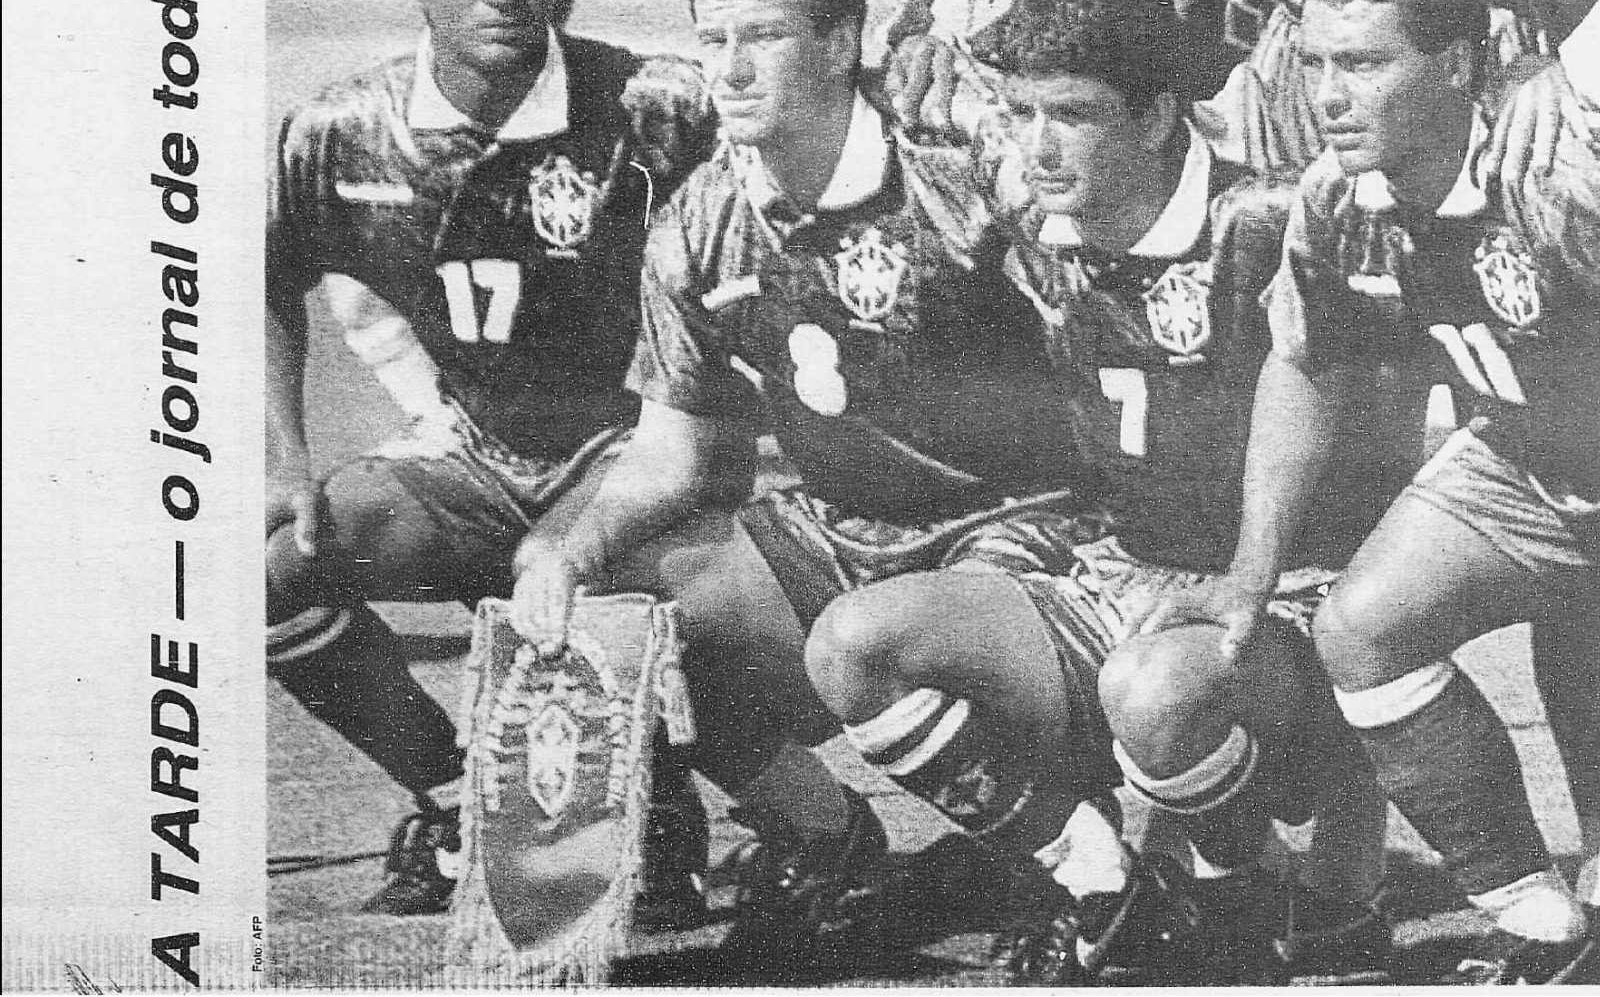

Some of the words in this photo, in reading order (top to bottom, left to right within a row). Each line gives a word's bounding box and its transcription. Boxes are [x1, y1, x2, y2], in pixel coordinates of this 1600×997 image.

[151, 133, 198, 224] de
[435, 258, 521, 344] 17
[151, 241, 211, 463] jornal
[788, 323, 846, 416] 8
[1099, 367, 1148, 456] 7
[162, 475, 199, 521] o
[151, 634, 199, 901] TARDE
[152, 932, 200, 987] A
[252, 915, 264, 940] AFP
[252, 942, 264, 973] Foto:
